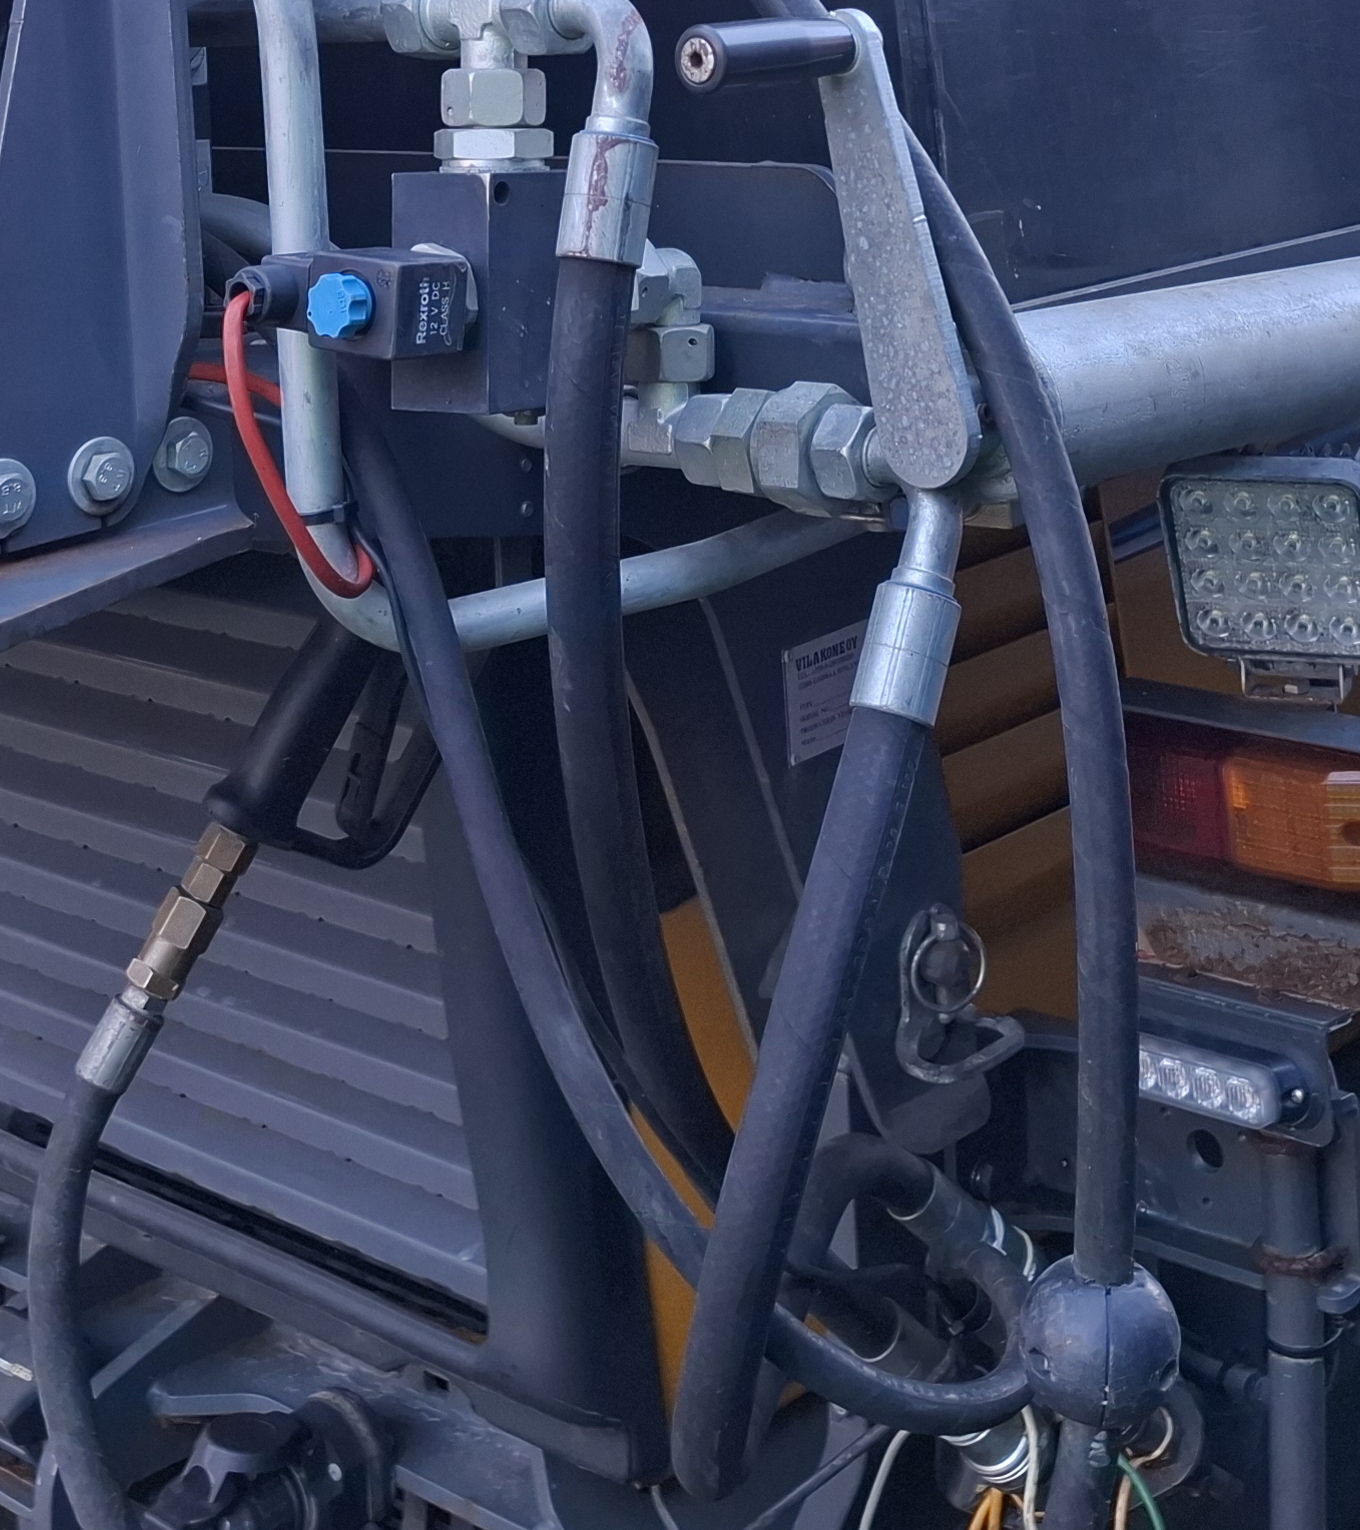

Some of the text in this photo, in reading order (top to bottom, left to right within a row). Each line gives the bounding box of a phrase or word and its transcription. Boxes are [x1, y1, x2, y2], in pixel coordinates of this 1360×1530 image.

[416, 277, 430, 345] Rexroth
[430, 282, 441, 335] 12 V DC
[439, 281, 451, 336] CLASS H
[795, 639, 846, 672] VILAKONE
